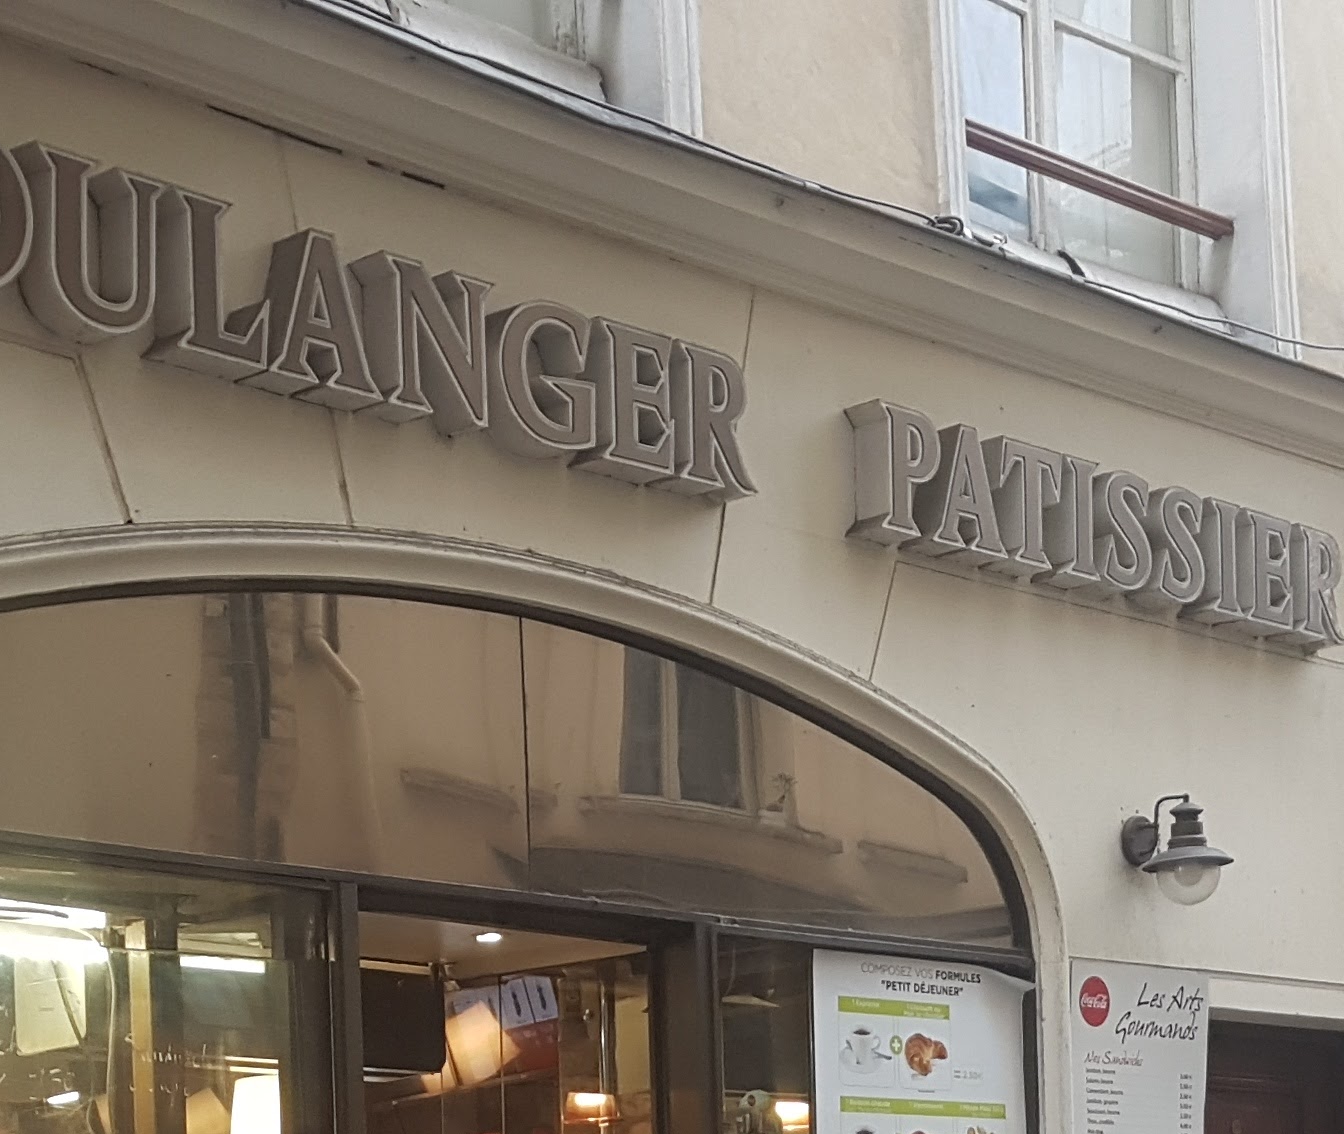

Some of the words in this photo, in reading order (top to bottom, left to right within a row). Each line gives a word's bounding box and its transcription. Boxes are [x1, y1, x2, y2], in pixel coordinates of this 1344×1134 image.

[935, 968, 982, 985] FORMULES
[1136, 981, 1166, 1010] Les
[1166, 985, 1205, 1013] Arts
[1114, 1010, 1199, 1045] Gourmands
